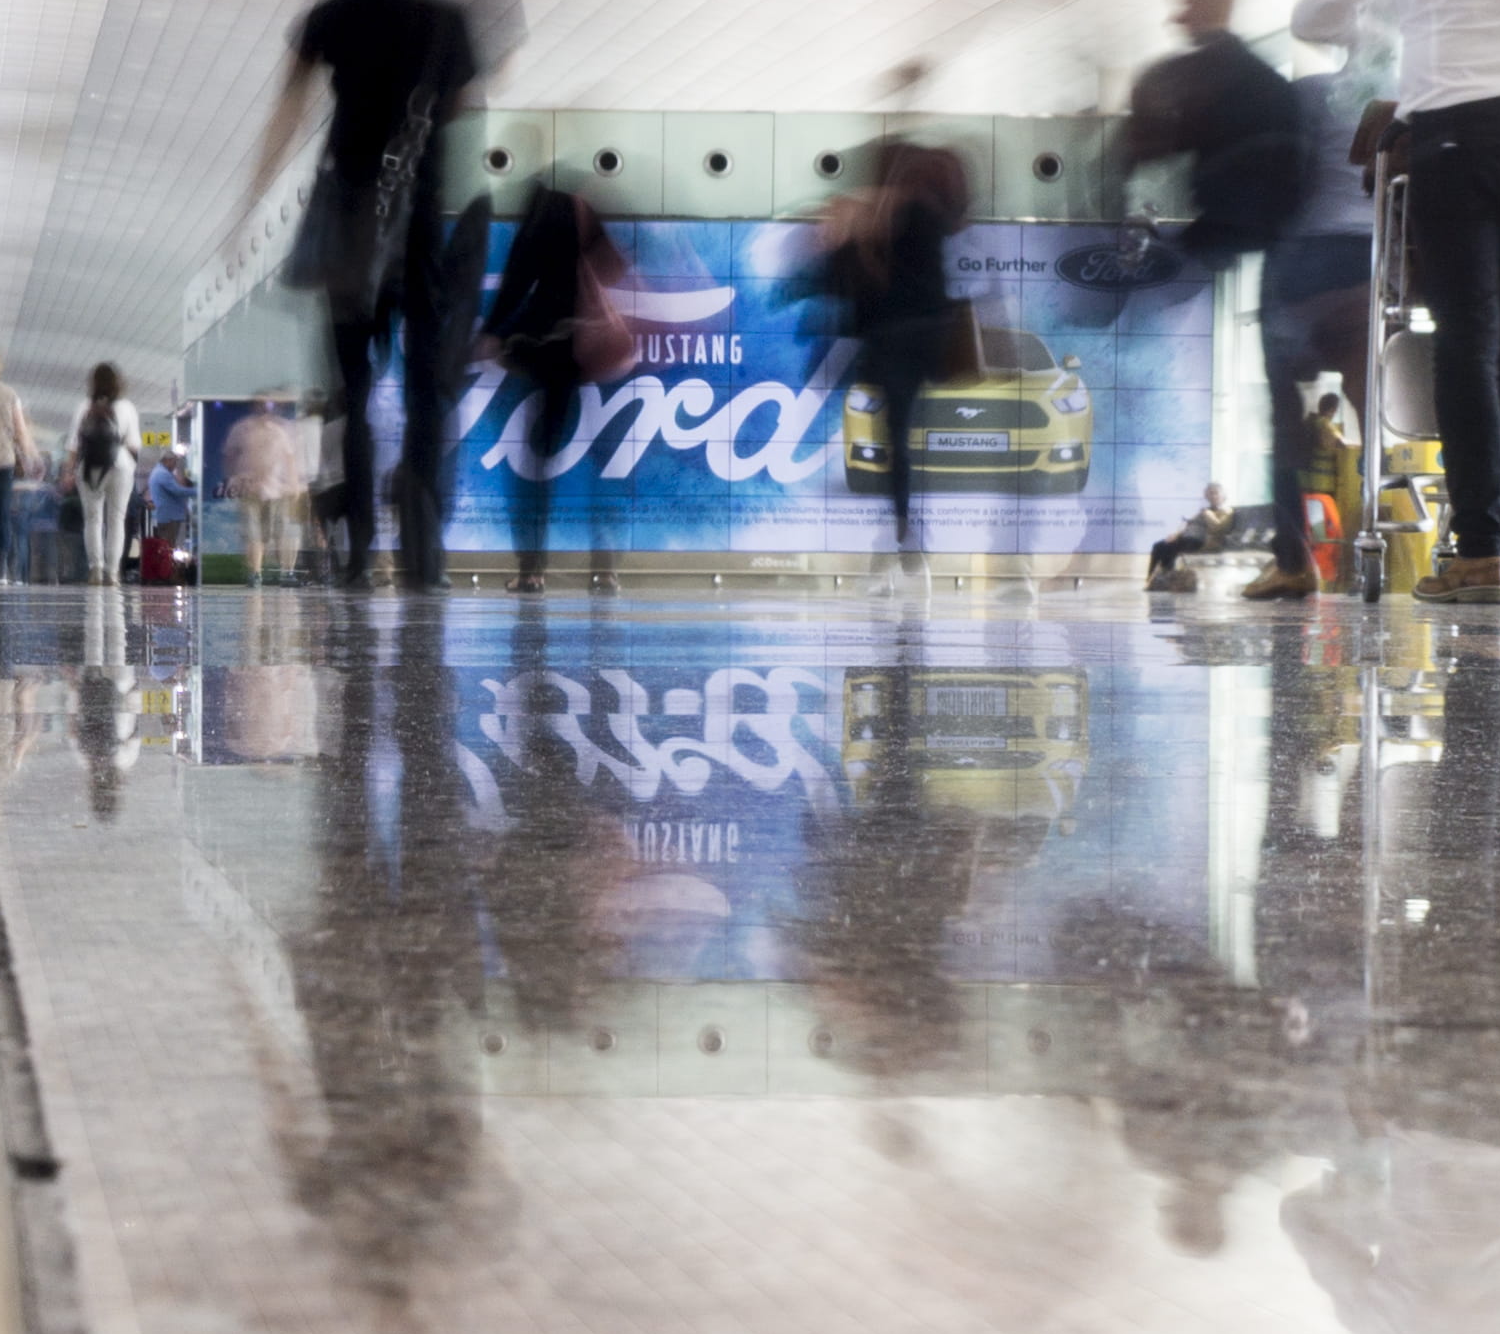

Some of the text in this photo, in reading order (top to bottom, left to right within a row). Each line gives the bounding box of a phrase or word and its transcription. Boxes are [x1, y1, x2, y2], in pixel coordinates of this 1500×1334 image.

[958, 256, 1047, 273] Go Further
[937, 438, 998, 448] MUSTANG
